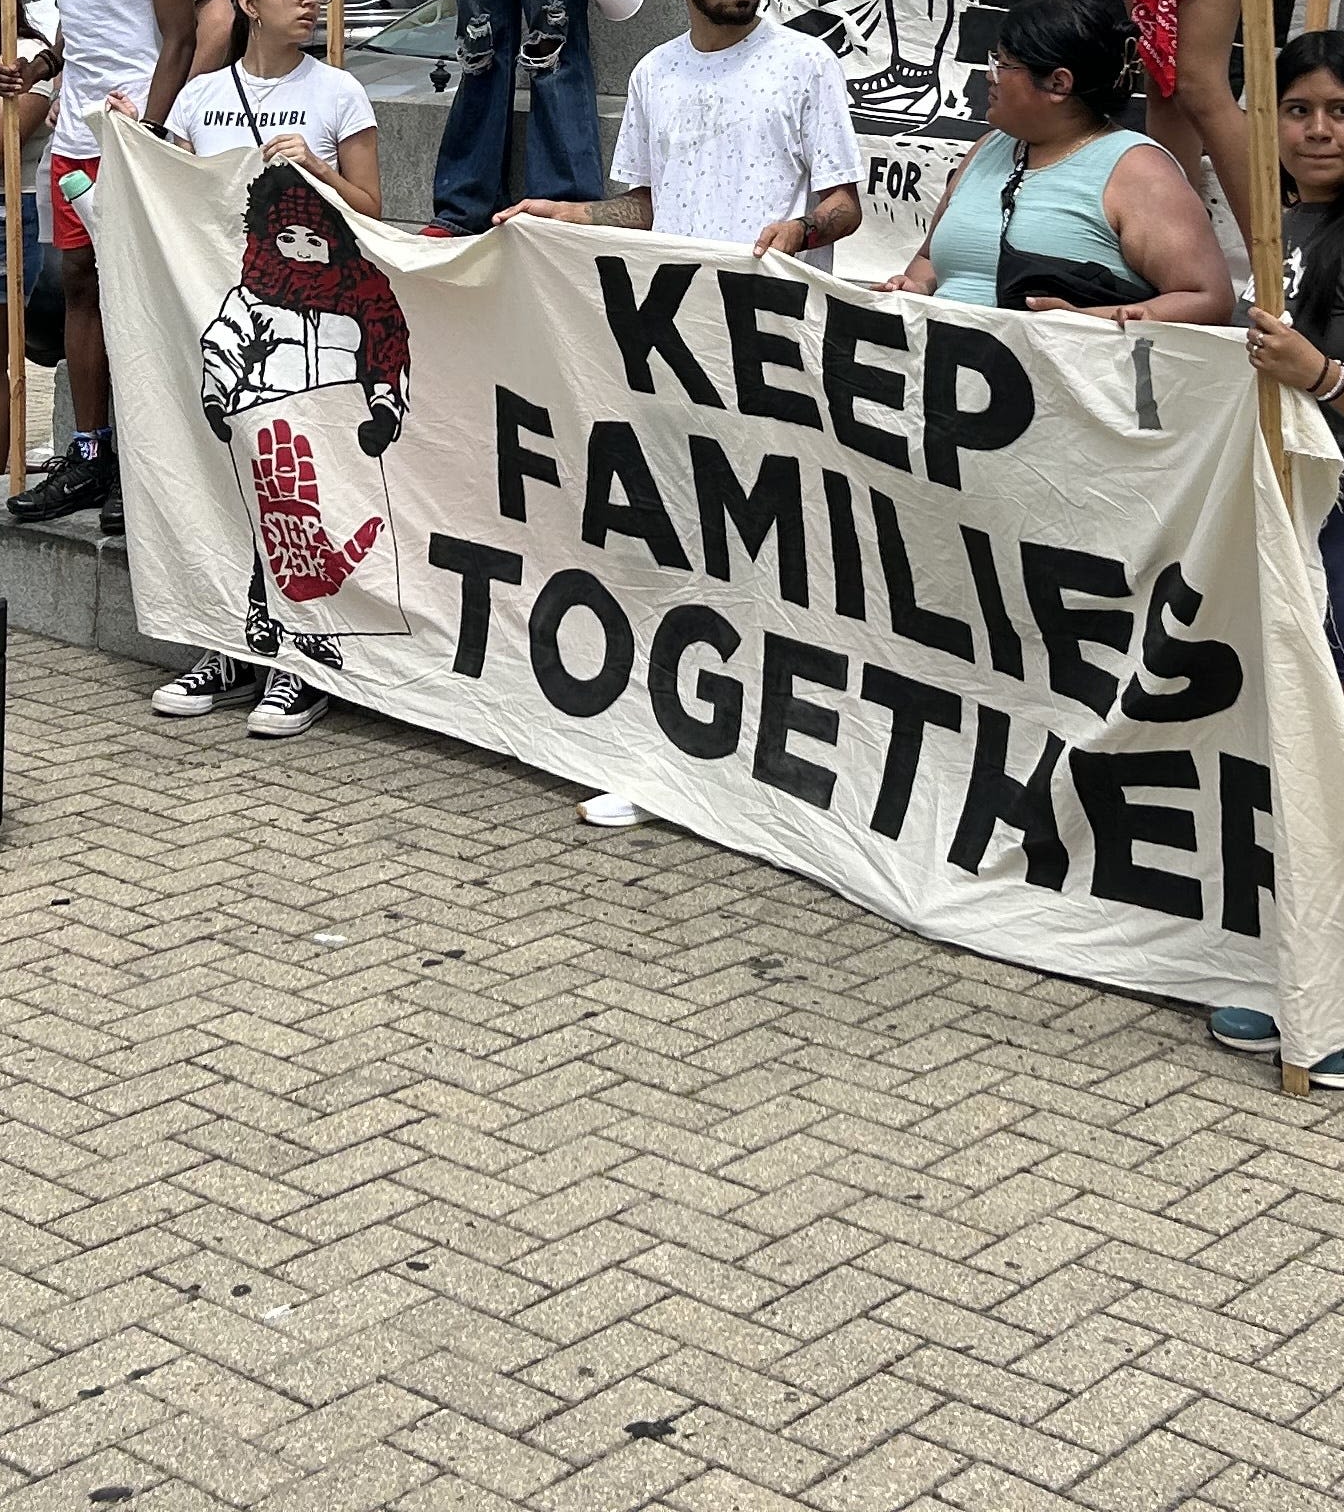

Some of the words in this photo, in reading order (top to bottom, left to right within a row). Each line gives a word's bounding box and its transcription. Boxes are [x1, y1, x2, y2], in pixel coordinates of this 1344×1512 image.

[867, 156, 922, 203] FOR
[596, 256, 1034, 490] KEEP
[495, 384, 1244, 723] FAMILIES
